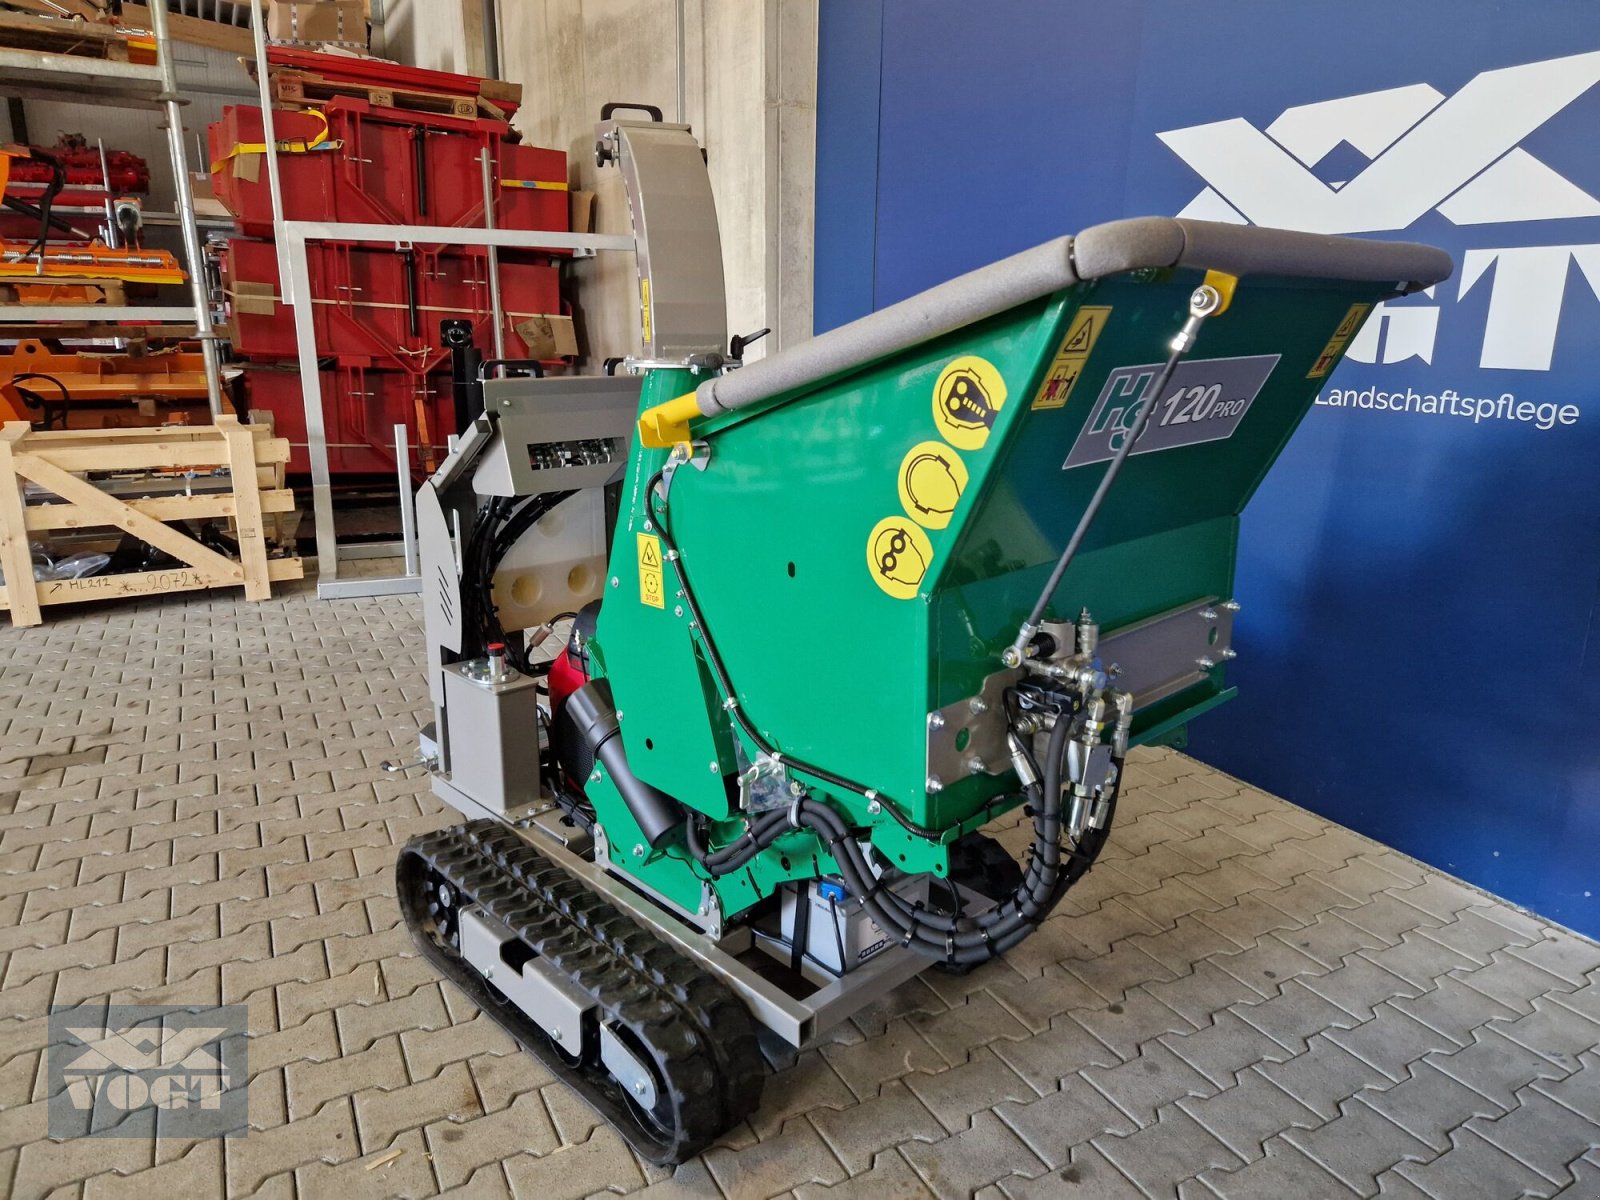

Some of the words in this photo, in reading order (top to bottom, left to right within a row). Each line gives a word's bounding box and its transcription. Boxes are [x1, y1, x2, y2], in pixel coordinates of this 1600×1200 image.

[1160, 384, 1222, 426] 120
[1209, 399, 1244, 418] PRO
[1314, 386, 1580, 430] Landschaftspflege
[645, 594, 659, 603] STOP
